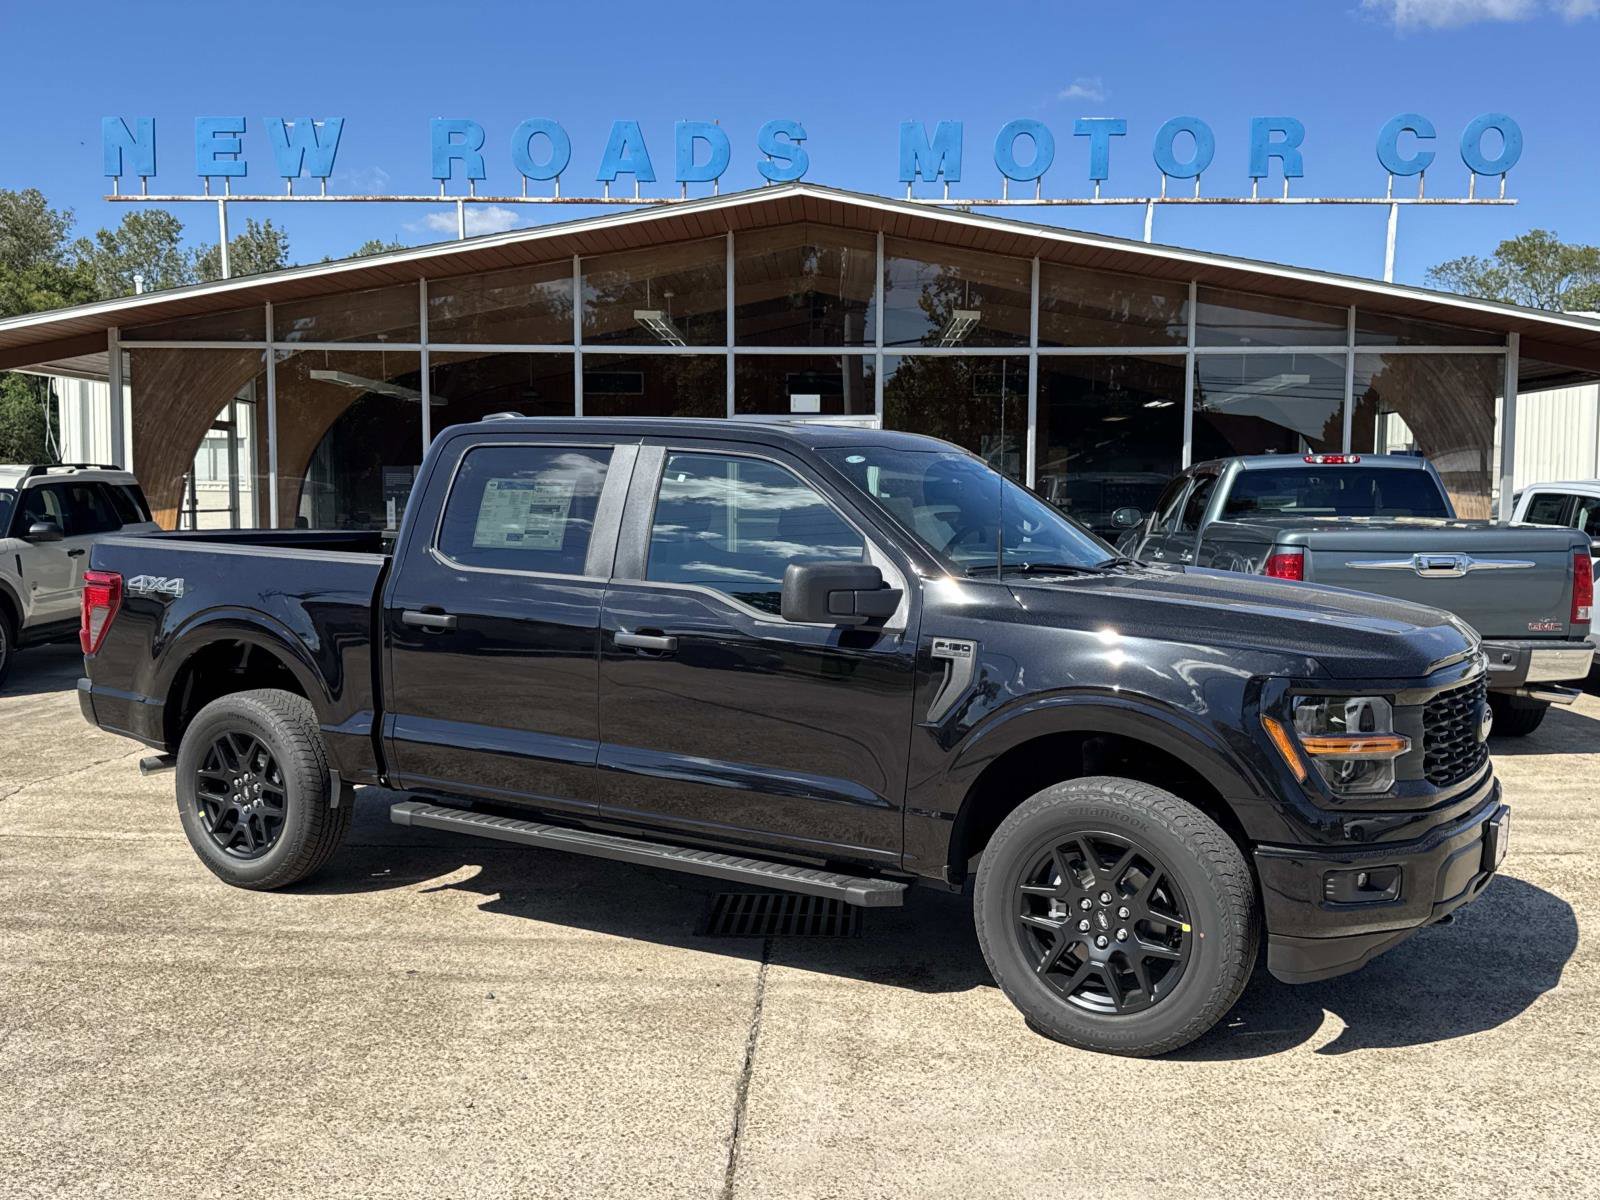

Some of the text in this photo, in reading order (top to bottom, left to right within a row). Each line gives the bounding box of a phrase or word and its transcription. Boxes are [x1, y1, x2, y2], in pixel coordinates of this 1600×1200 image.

[102, 112, 1524, 183] NEW ROADS MOTOR CO
[934, 641, 972, 652] F-150
